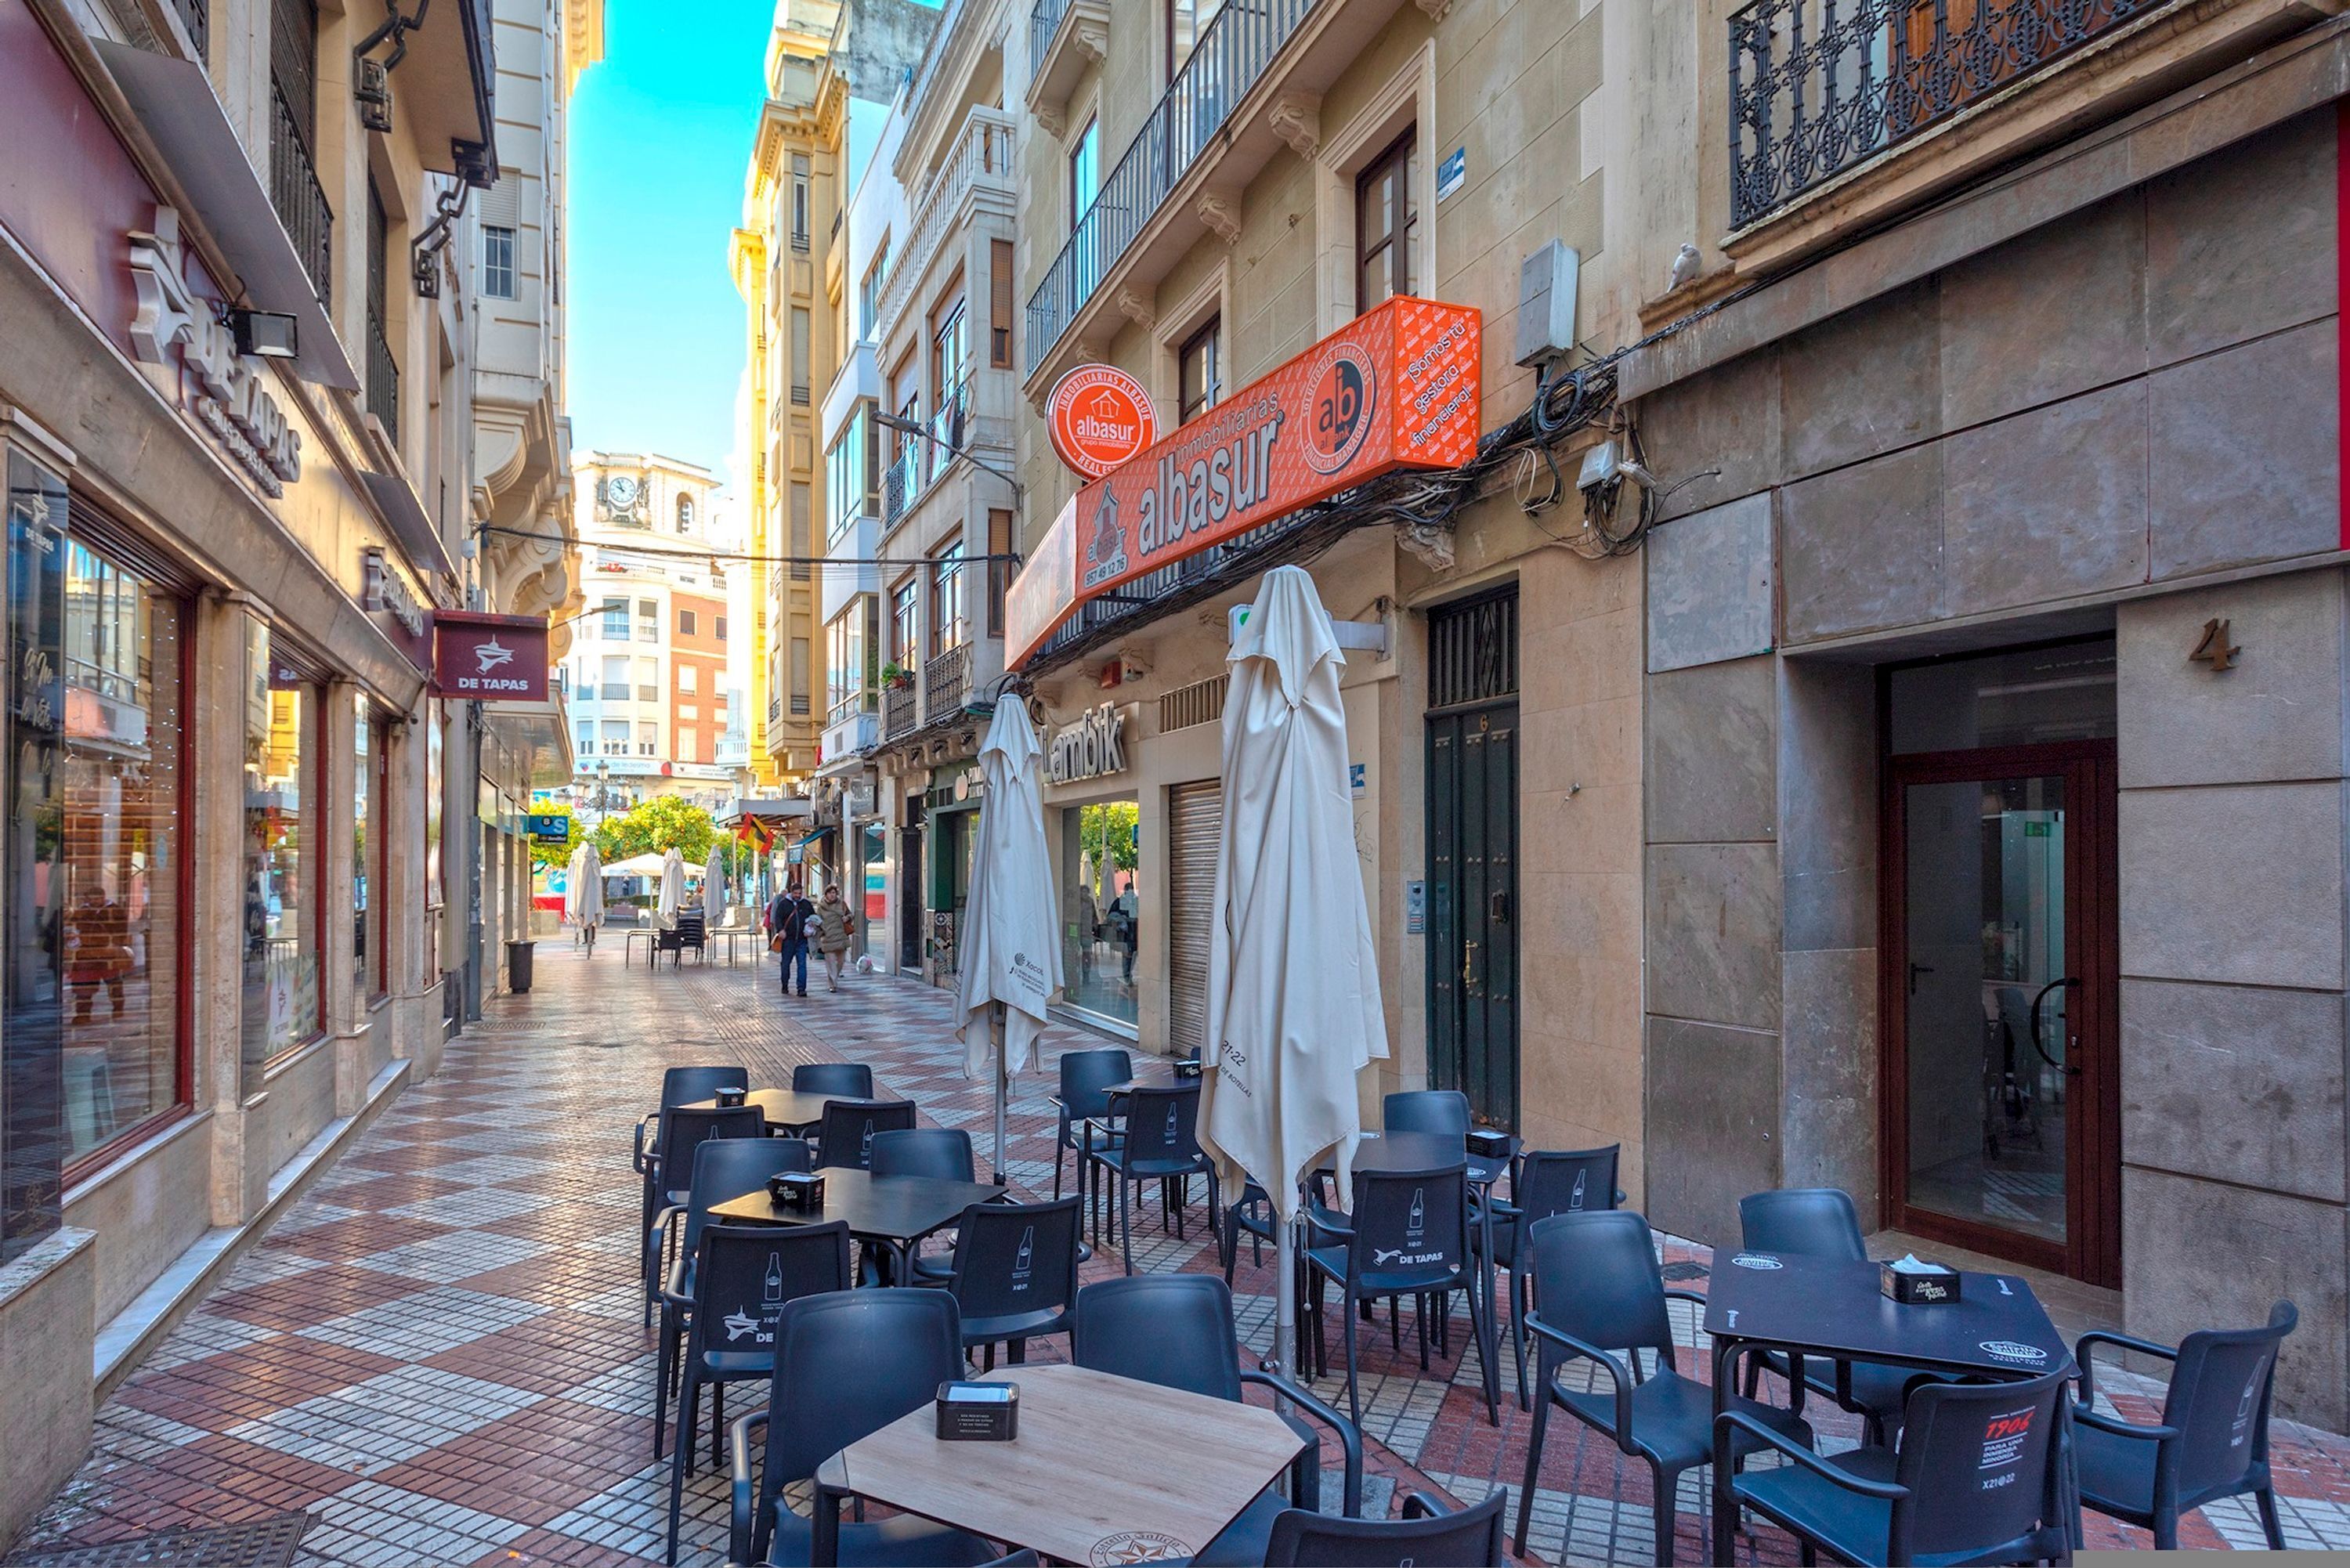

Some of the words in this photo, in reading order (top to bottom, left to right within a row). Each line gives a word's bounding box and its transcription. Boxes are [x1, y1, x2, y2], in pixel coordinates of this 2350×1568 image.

[1303, 355, 1332, 417] SOLUCIONES
[1334, 346, 1371, 385] FINANCIERAS
[1414, 363, 1459, 415] gestora
[1058, 372, 1119, 411] INMOBILIARIAS
[1120, 380, 1151, 421] ALBASUR
[1076, 415, 1135, 441] albasur
[1177, 392, 1278, 464] inmobiliarias
[1304, 443, 1335, 470] FINANCIAL
[1335, 414, 1368, 463] MANAGER
[1077, 456, 1101, 474] REAL
[1138, 418, 1279, 556] albasur
[1085, 571, 1097, 587] 957
[1097, 567, 1107, 579] 49
[1107, 563, 1115, 576] 12
[1115, 560, 1126, 572] 76
[2188, 618, 2242, 672] 4
[458, 677, 479, 689] DE
[482, 677, 529, 690] TAPAS
[1480, 714, 1488, 733] 6
[1039, 700, 1128, 786] Lambik
[1227, 1073, 1252, 1097] BOTELLAS
[1399, 1255, 1414, 1264] DE
[1415, 1251, 1444, 1263] TAPAS
[756, 1332, 774, 1343] DE
[1985, 1411, 2034, 1439] 1906
[1983, 1445, 2018, 1458] INMENSA
[1984, 1443, 2007, 1452] PARA
[2008, 1437, 2023, 1447] UNA
[1094, 1534, 1130, 1555] Estrella
[1133, 1533, 1180, 1548] Galicia
